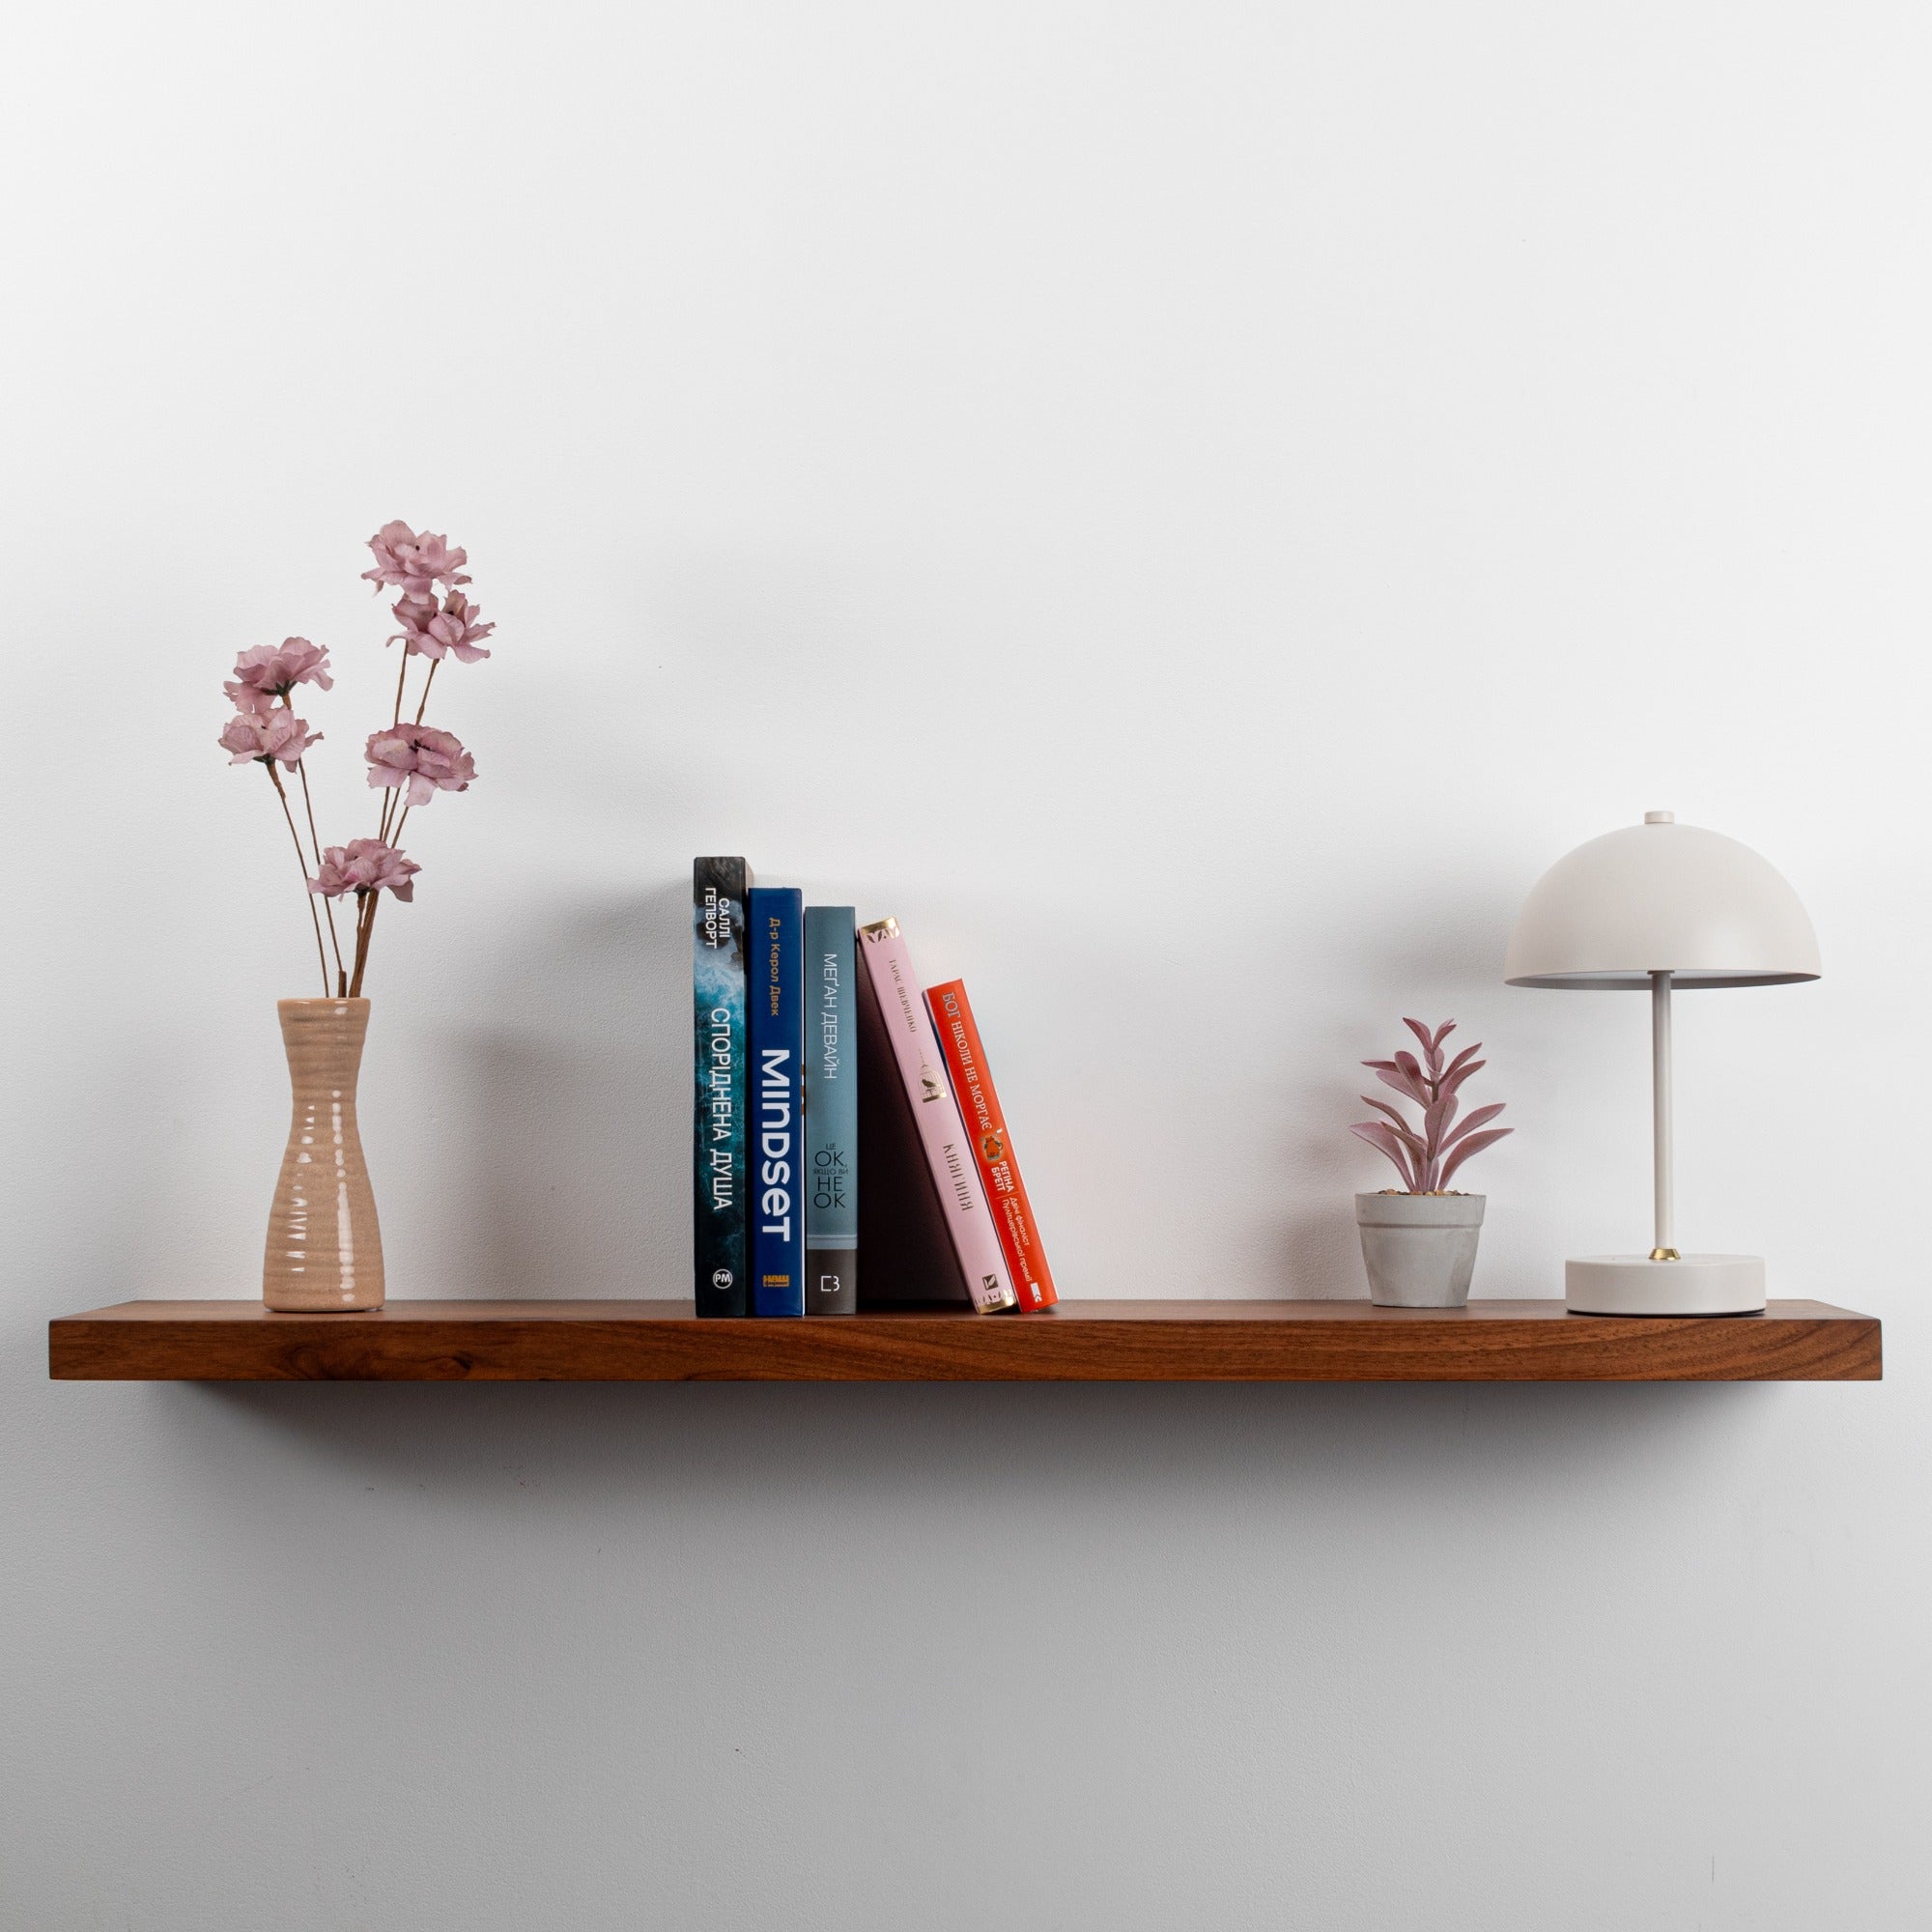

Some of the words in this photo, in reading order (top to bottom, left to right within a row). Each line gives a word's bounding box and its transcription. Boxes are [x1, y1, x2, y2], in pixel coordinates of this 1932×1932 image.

[705, 887, 717, 949] ГЕПВОРТ
[719, 897, 730, 938] САЛЛІ
[769, 944, 781, 982] Керол
[823, 953, 839, 1008] МЕҐАН
[769, 985, 781, 1016] Двек
[942, 991, 961, 1018] БОГ
[821, 1011, 839, 1079] ДЕВАЙН
[951, 1021, 974, 1065] НІКОЛИ
[709, 1008, 732, 1141] СПОРІДНЕНА
[964, 1066, 979, 1083] НЕ
[970, 1083, 993, 1131] МОРГАЄ
[709, 1149, 732, 1210] ДУША
[817, 1176, 843, 1192] НЕ
[943, 1143, 974, 1211] КНЯГИНЯ
[813, 1192, 846, 1209] ОК
